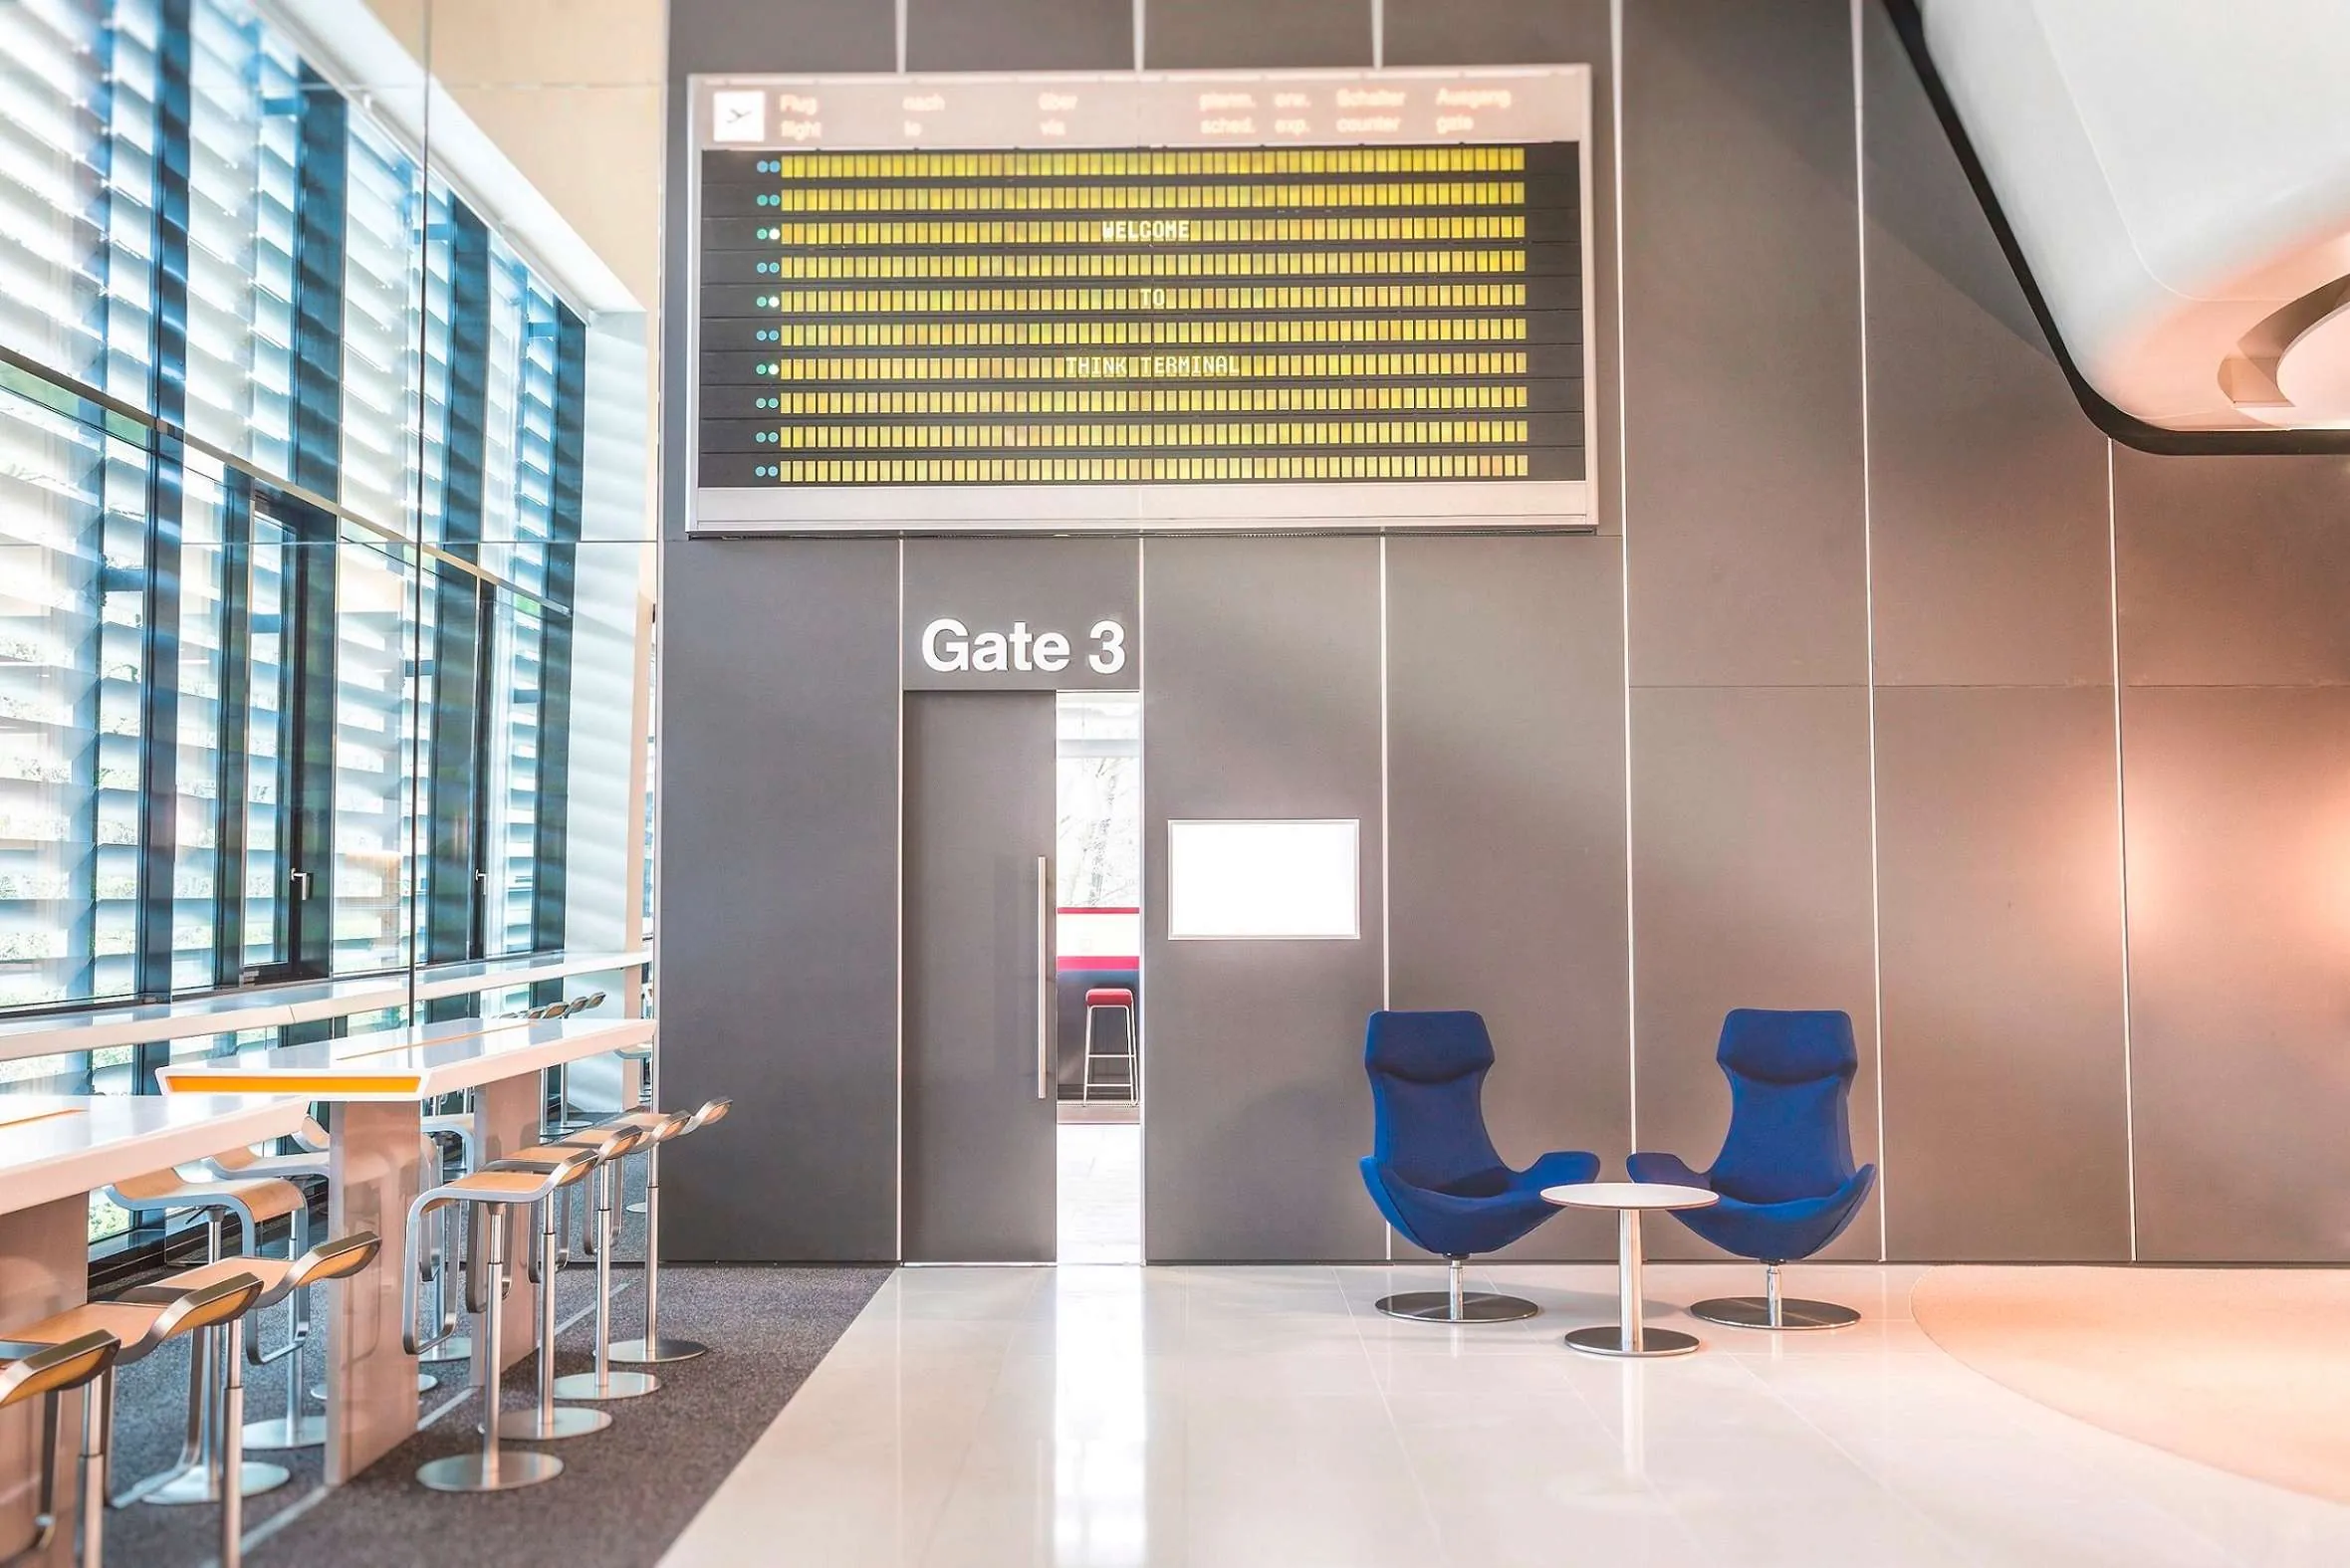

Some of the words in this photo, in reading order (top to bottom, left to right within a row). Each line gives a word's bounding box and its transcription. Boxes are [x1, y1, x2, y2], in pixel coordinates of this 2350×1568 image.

[1102, 220, 1190, 240] WELCOME
[1141, 288, 1165, 308] TO
[1065, 356, 1127, 376] THINK
[1141, 355, 1240, 376] TERMINAL
[922, 618, 1070, 672] Gate
[1088, 620, 1126, 674] 3
